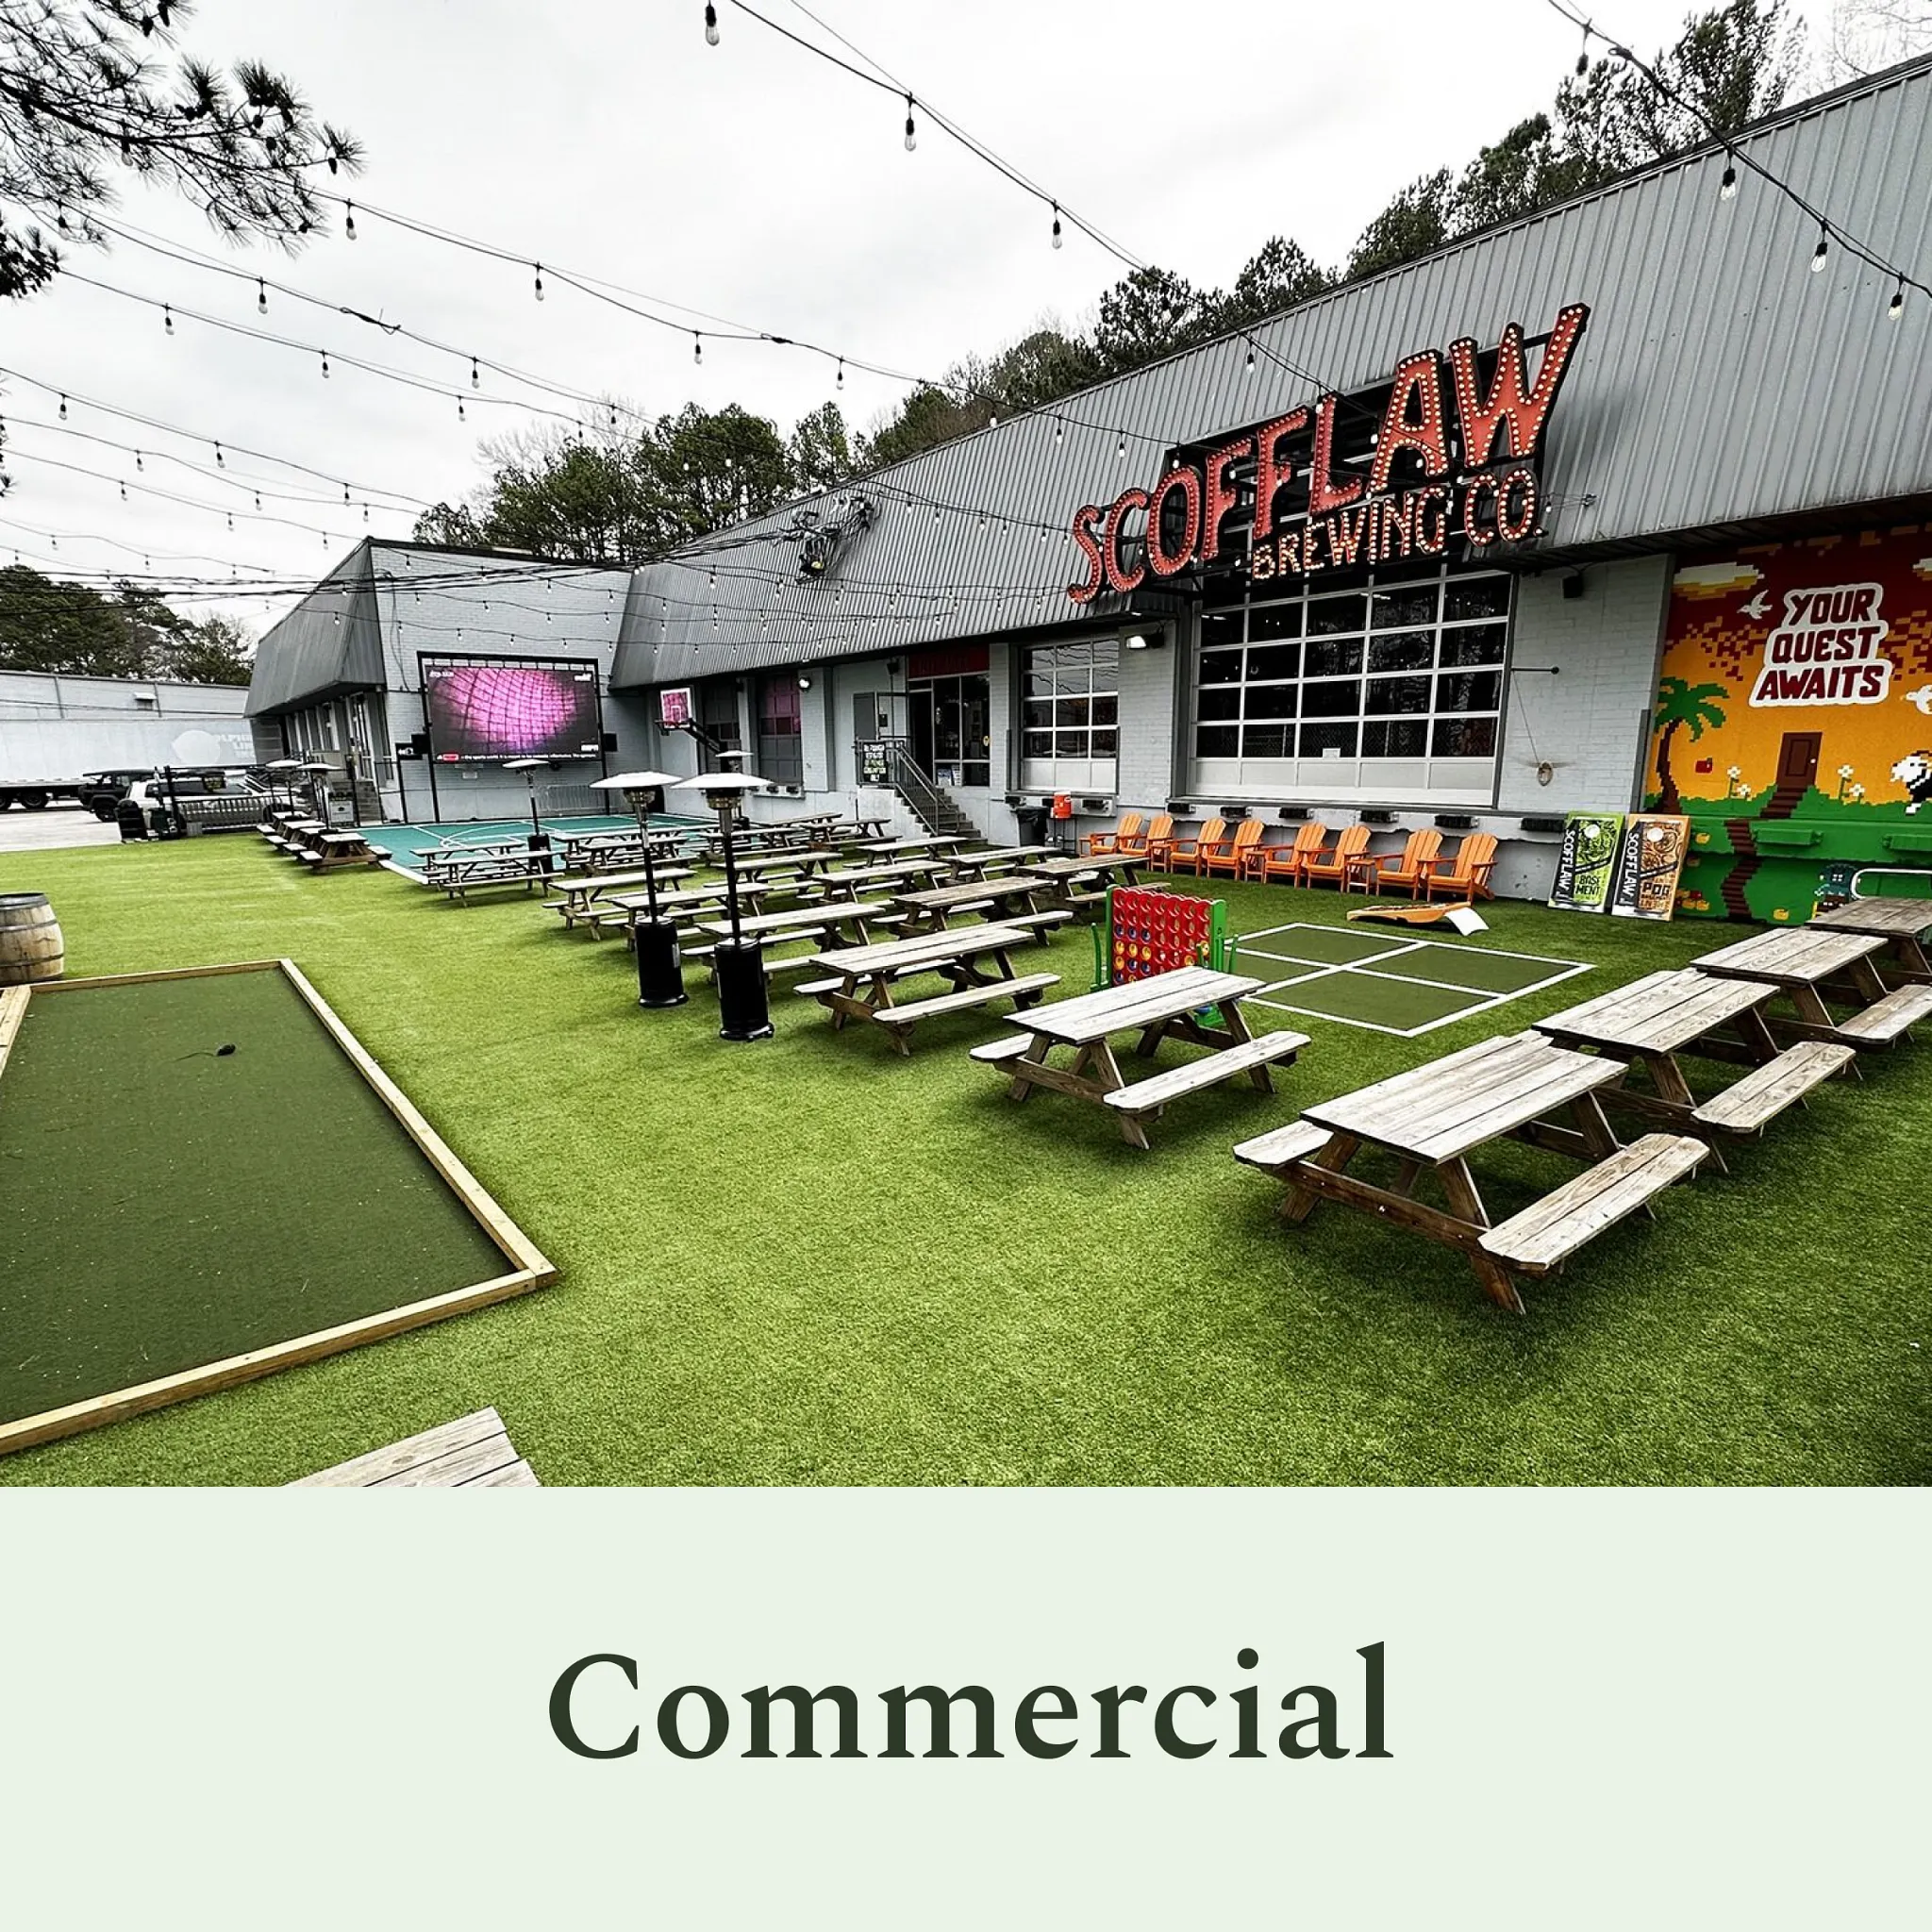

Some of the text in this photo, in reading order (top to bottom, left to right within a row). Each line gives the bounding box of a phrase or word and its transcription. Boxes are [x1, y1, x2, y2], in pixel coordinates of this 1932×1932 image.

[1067, 302, 1591, 605] SCOFFLAW
[1251, 484, 1446, 581] BREWING
[1789, 589, 1877, 626] YOUR
[1771, 625, 1882, 664] QUEST
[1755, 664, 1886, 702] AWAITS
[1558, 828, 1575, 891] SCOFFLAW
[1621, 832, 1640, 899] SCOFFLAW
[1574, 884, 1601, 895] MENT
[1642, 881, 1671, 897] POG
